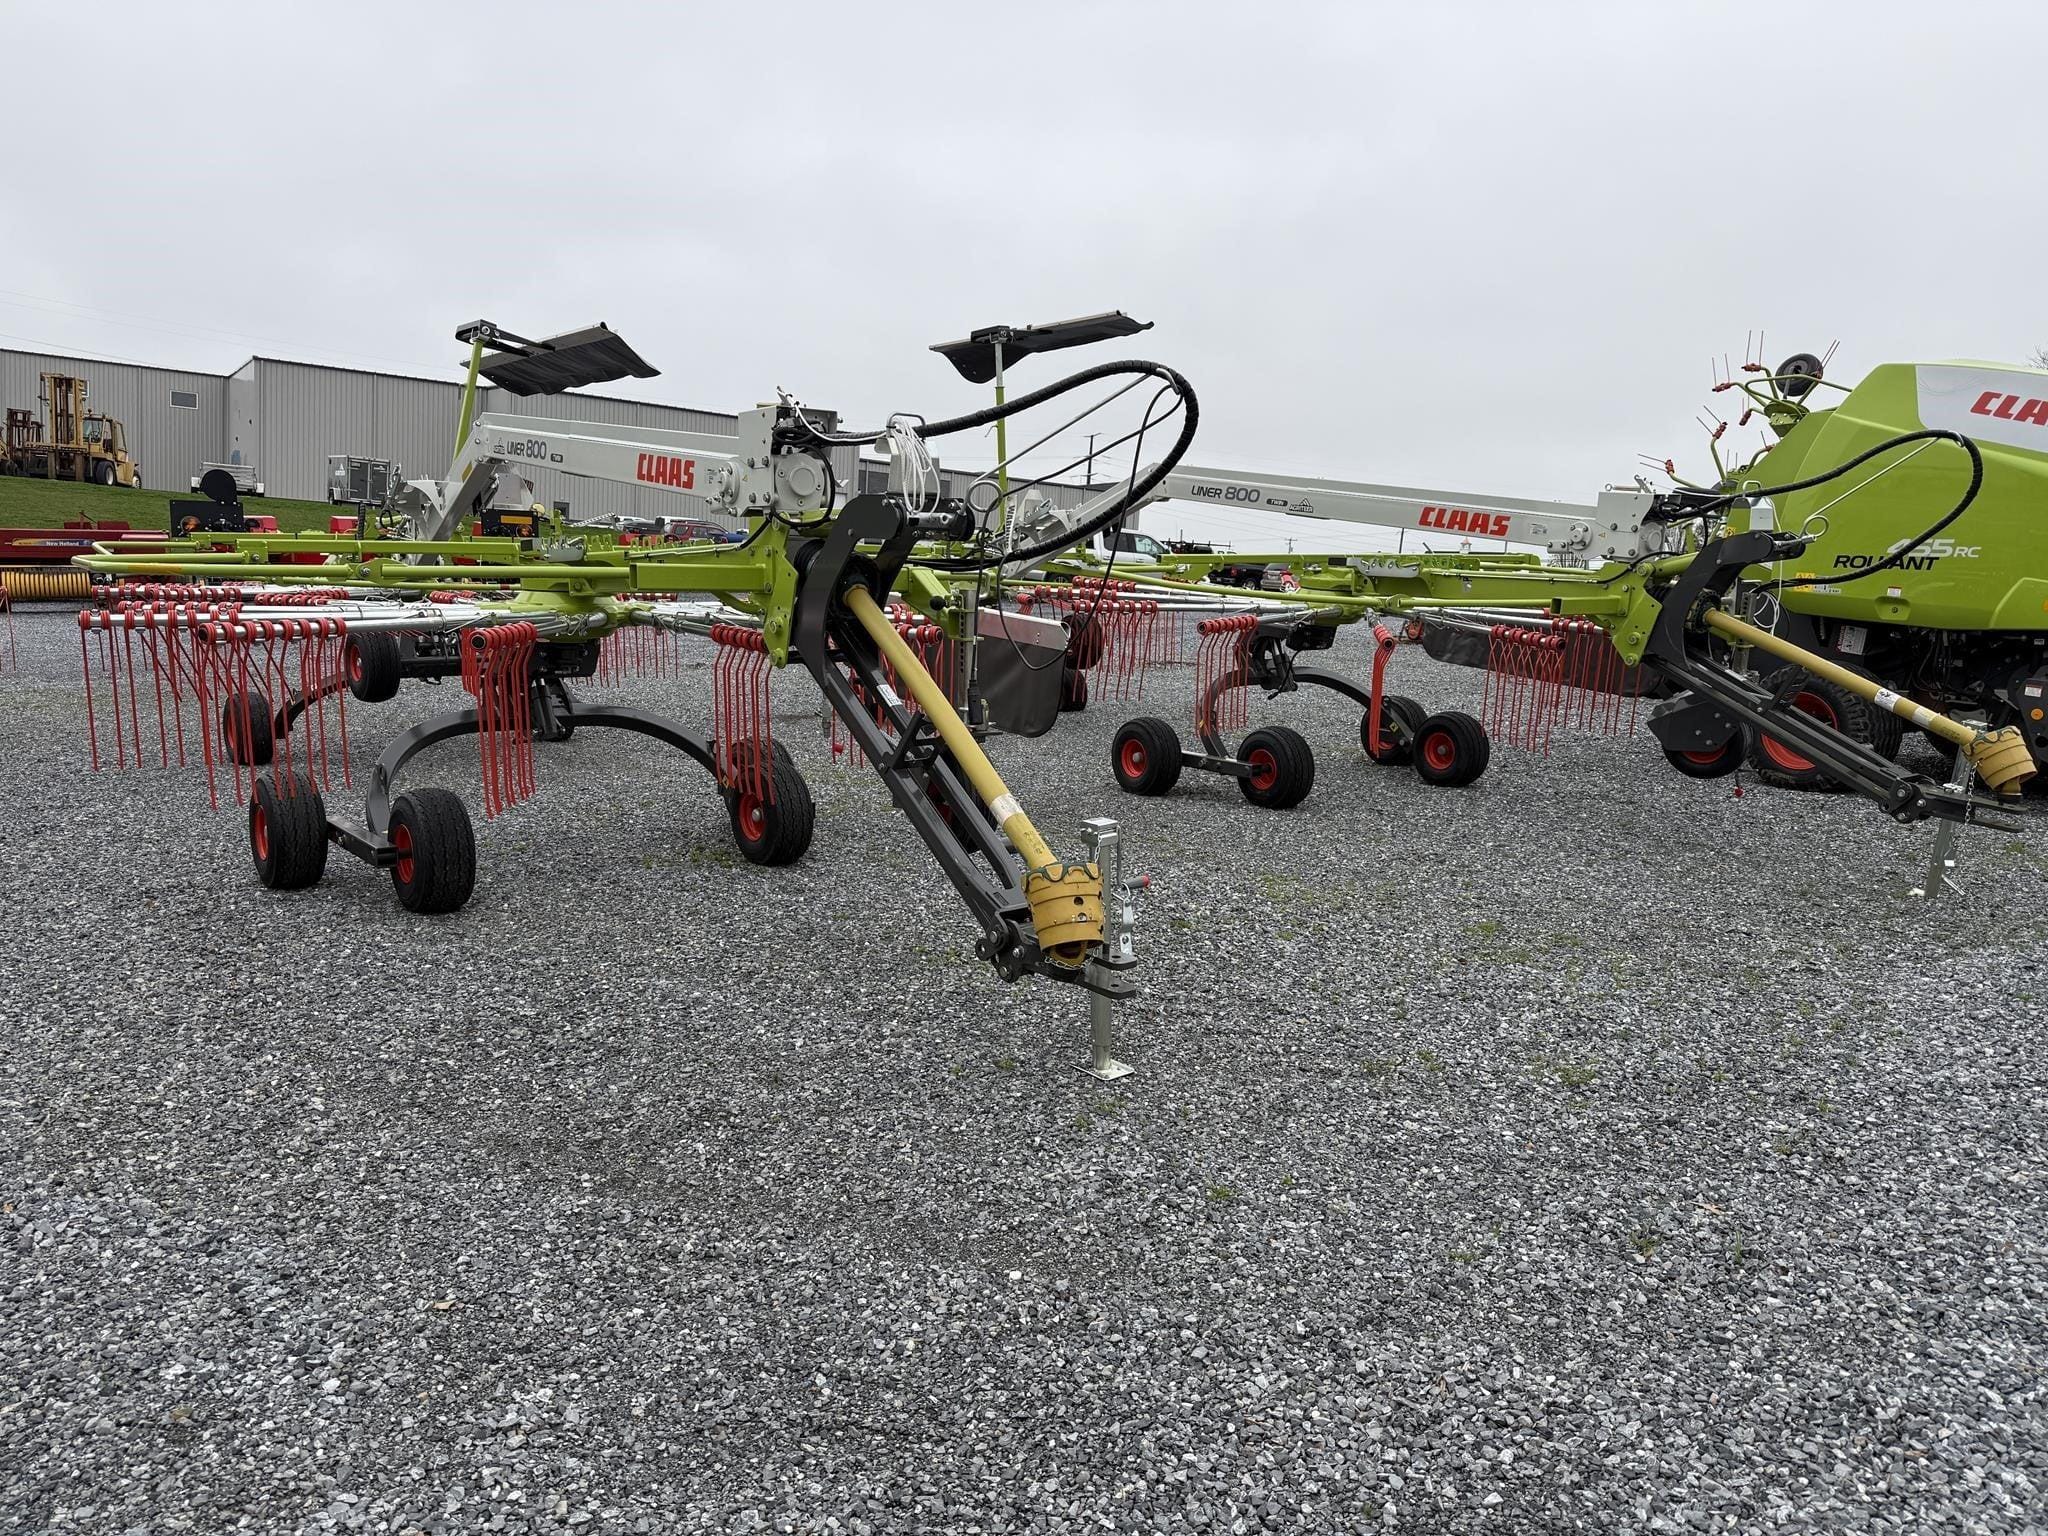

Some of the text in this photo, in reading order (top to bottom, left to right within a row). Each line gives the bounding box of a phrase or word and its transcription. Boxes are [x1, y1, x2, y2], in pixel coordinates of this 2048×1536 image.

[506, 440, 525, 457] LINER
[526, 439, 547, 460] 800
[637, 452, 696, 490] CLAAS
[1191, 485, 1222, 499] LINER
[1224, 486, 1260, 503] 800
[1418, 506, 1511, 537] CLAAS
[1953, 546, 1982, 558] RC
